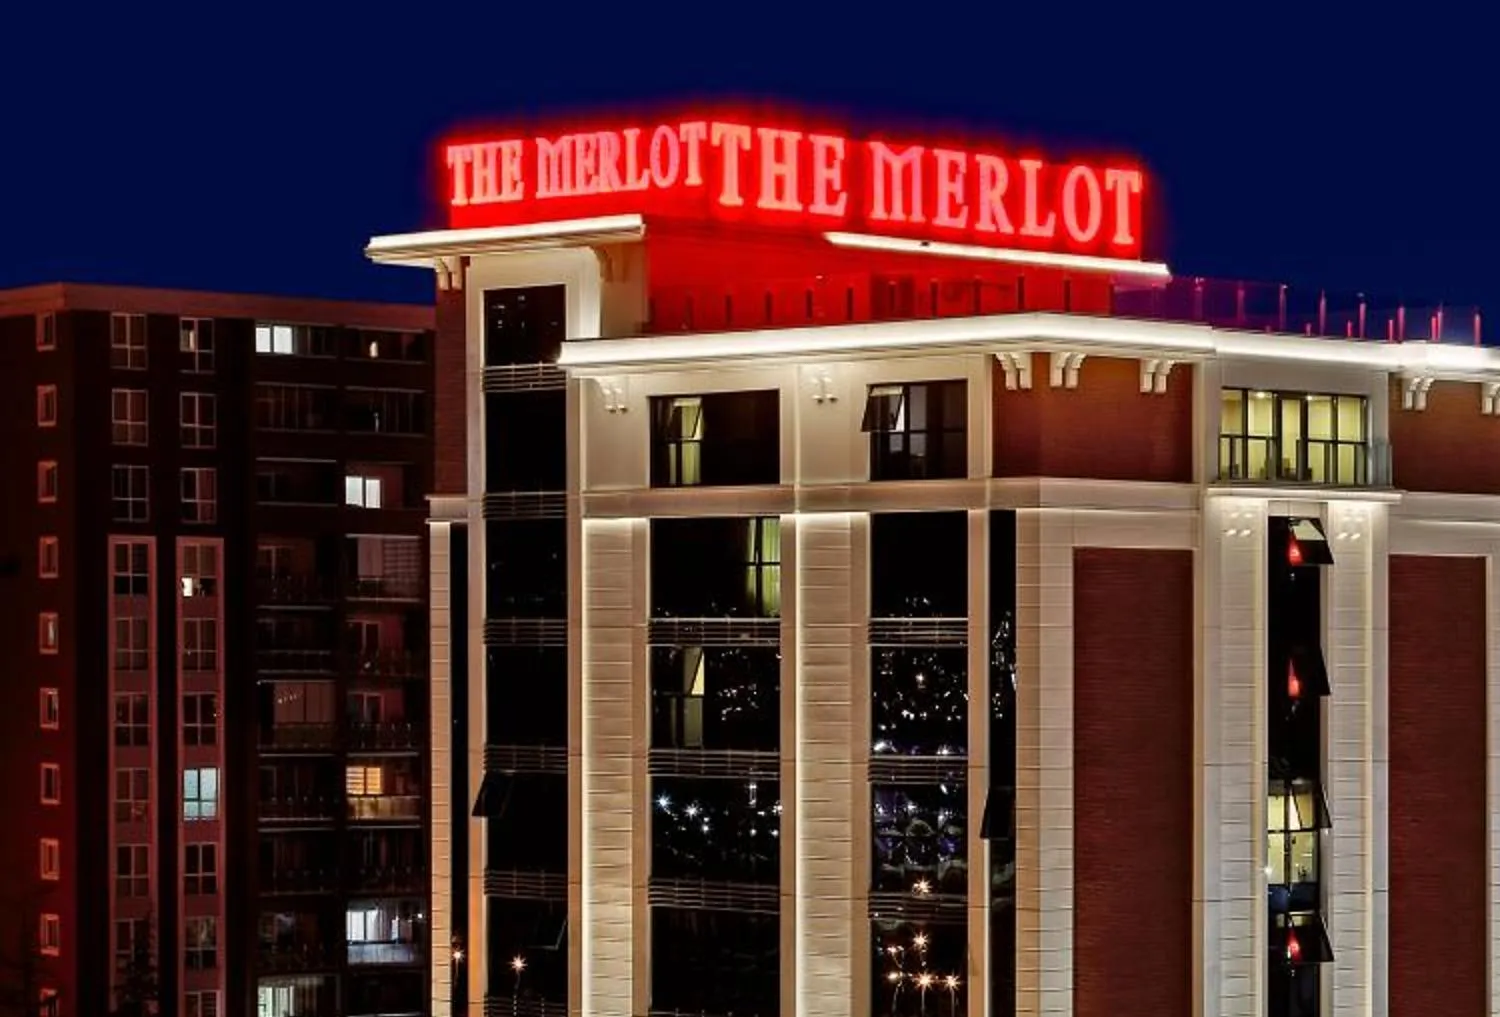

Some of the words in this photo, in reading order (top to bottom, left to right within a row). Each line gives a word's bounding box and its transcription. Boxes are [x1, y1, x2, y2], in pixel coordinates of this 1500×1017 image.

[448, 141, 523, 206] THE
[536, 121, 707, 199] MERLOT
[711, 122, 848, 217] THE
[870, 141, 1142, 245] MERLOT
